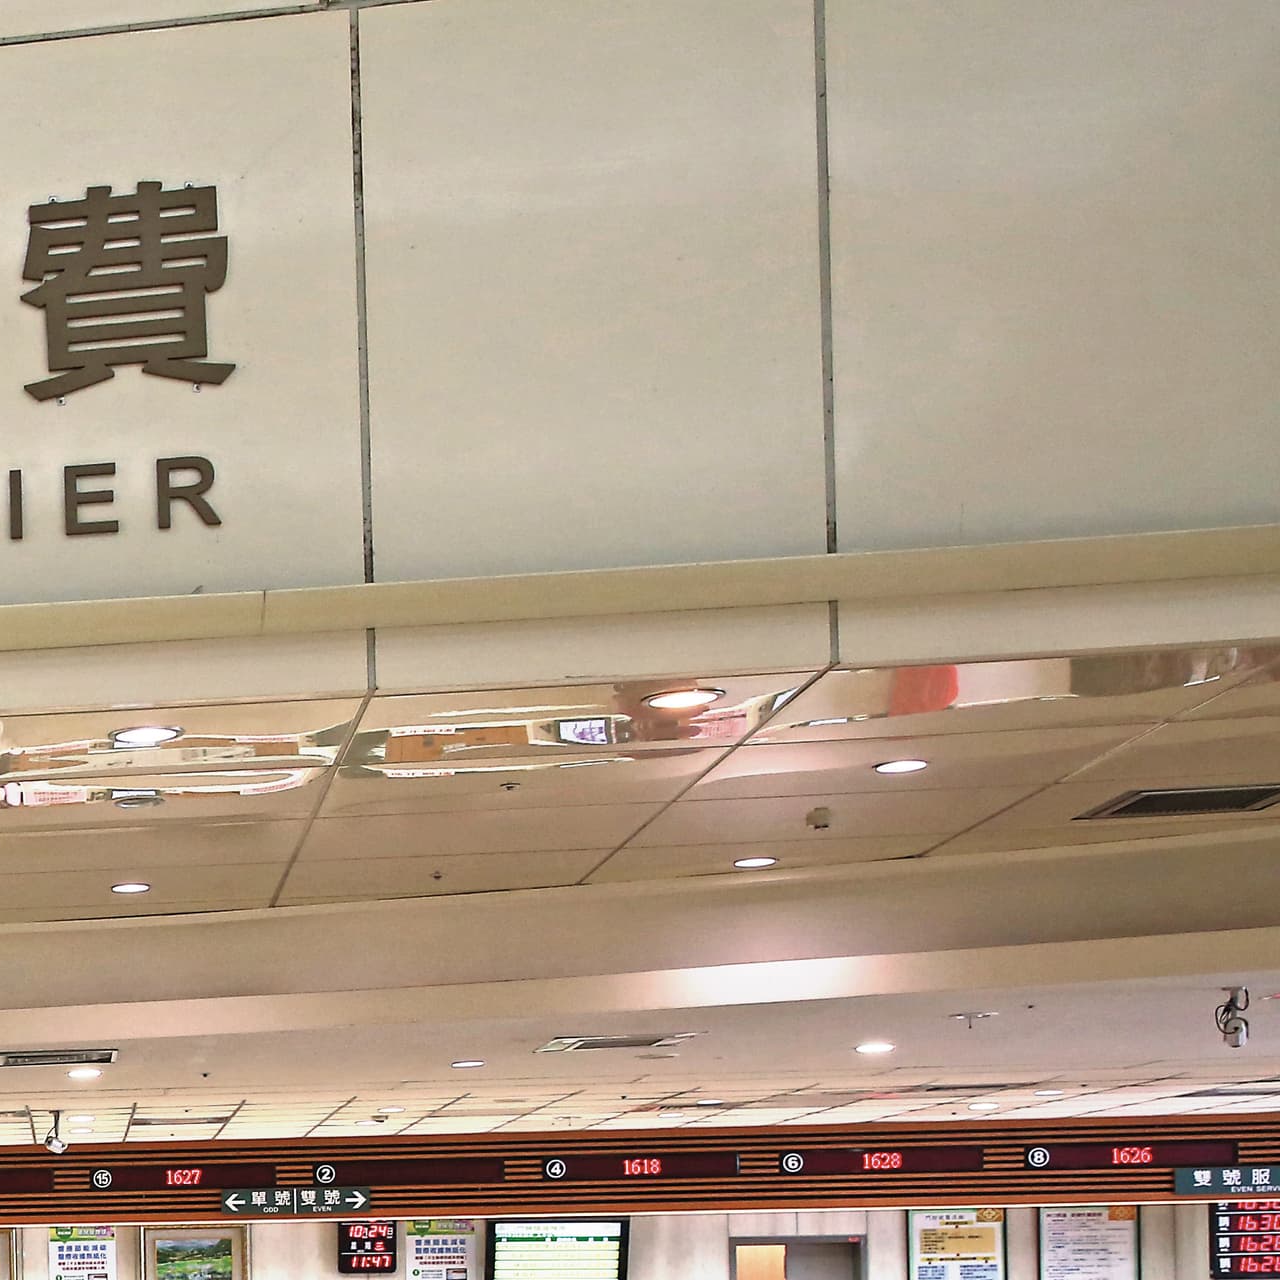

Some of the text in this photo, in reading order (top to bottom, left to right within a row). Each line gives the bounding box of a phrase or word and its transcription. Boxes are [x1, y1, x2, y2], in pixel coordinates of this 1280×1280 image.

[863, 1152, 903, 1169] 1628
[1111, 1146, 1152, 1164] 1626
[623, 1159, 661, 1174] 1618
[166, 1169, 202, 1184] 1627
[1193, 1168, 1270, 1186] 雙號服
[251, 1190, 341, 1206] 單號 雙號
[351, 1255, 392, 1268] 11:47
